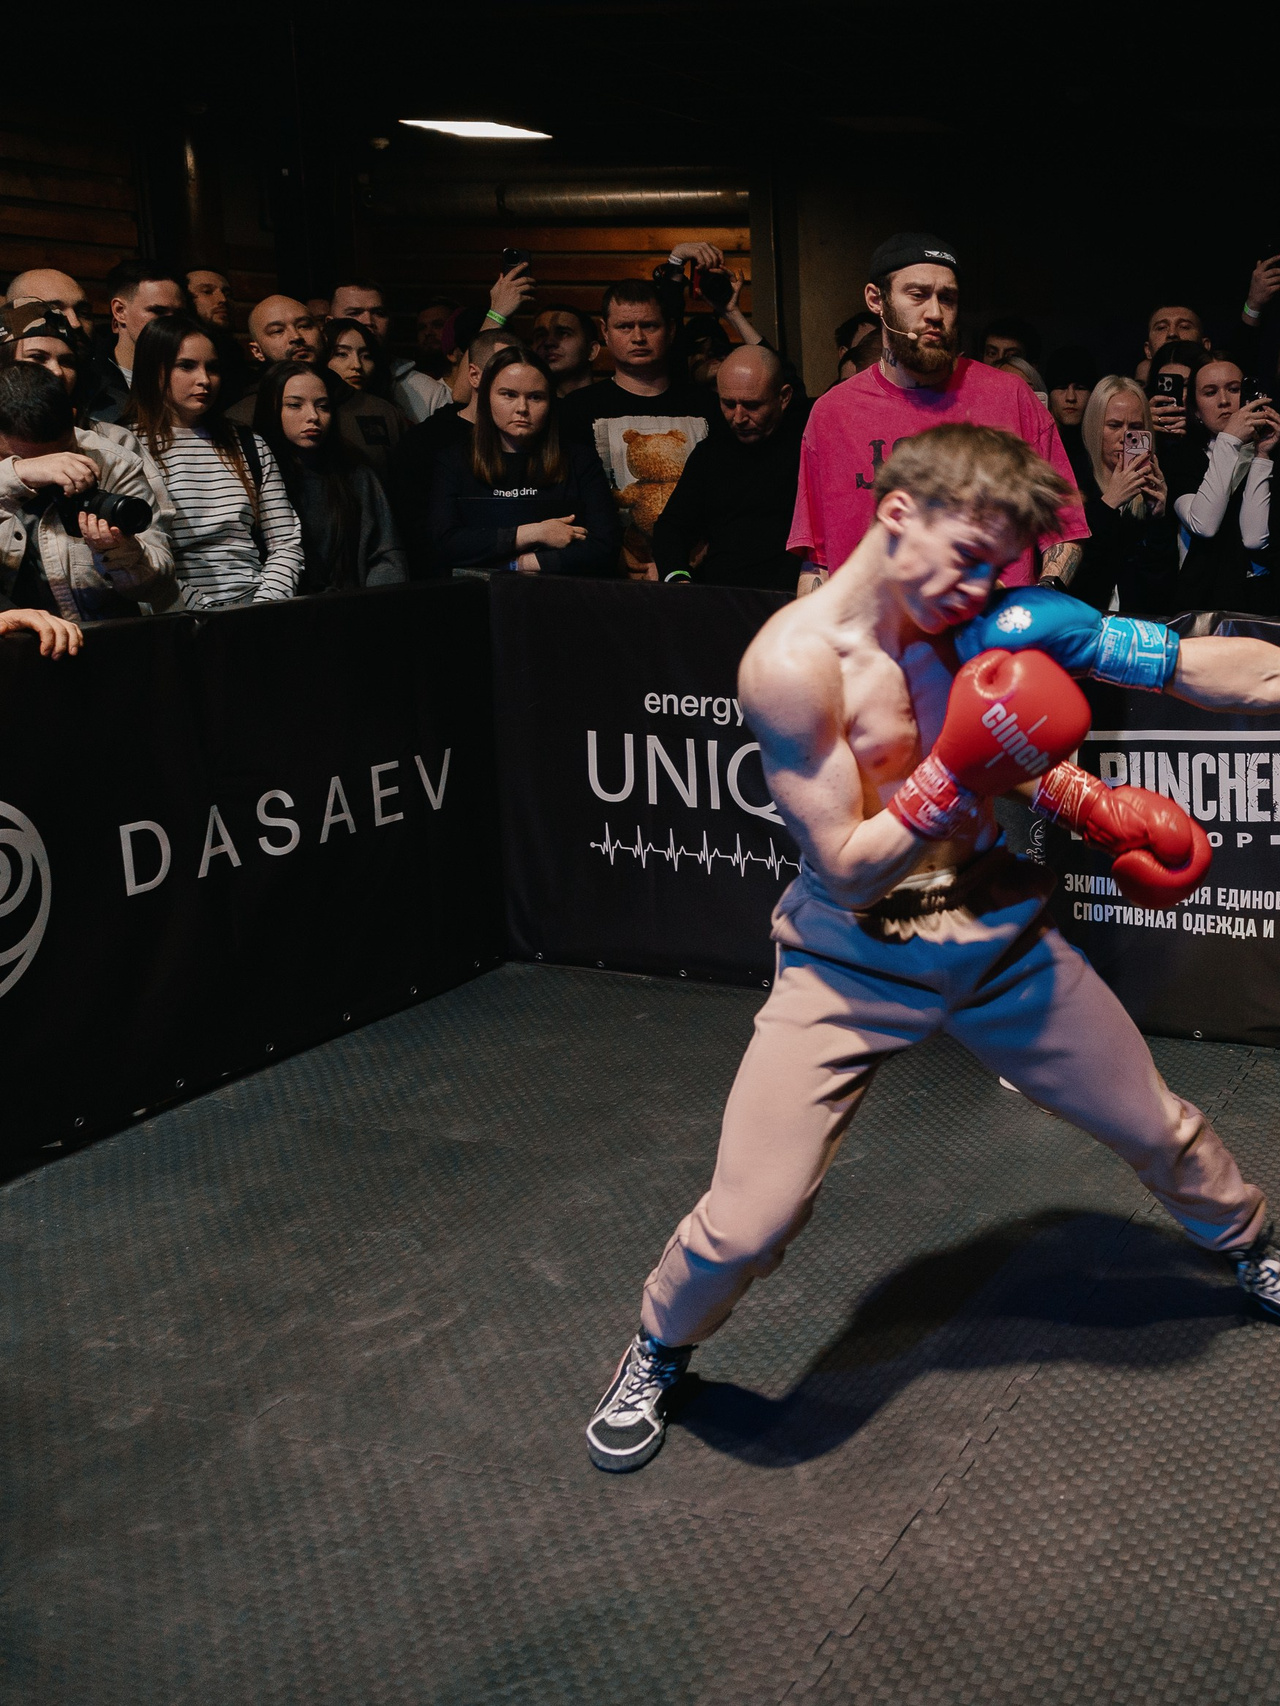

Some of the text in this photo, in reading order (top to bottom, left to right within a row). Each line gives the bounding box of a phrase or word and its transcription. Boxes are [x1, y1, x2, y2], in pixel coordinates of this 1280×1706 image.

[981, 702, 1050, 776] clinch
[119, 747, 452, 897] DASAEV
[1073, 901, 1177, 930] СПОРТИВНАЯ
[1182, 911, 1258, 940] ОДЕЖДА
[1262, 919, 1275, 939] И
[1175, 886, 1212, 907] ЛЯ
